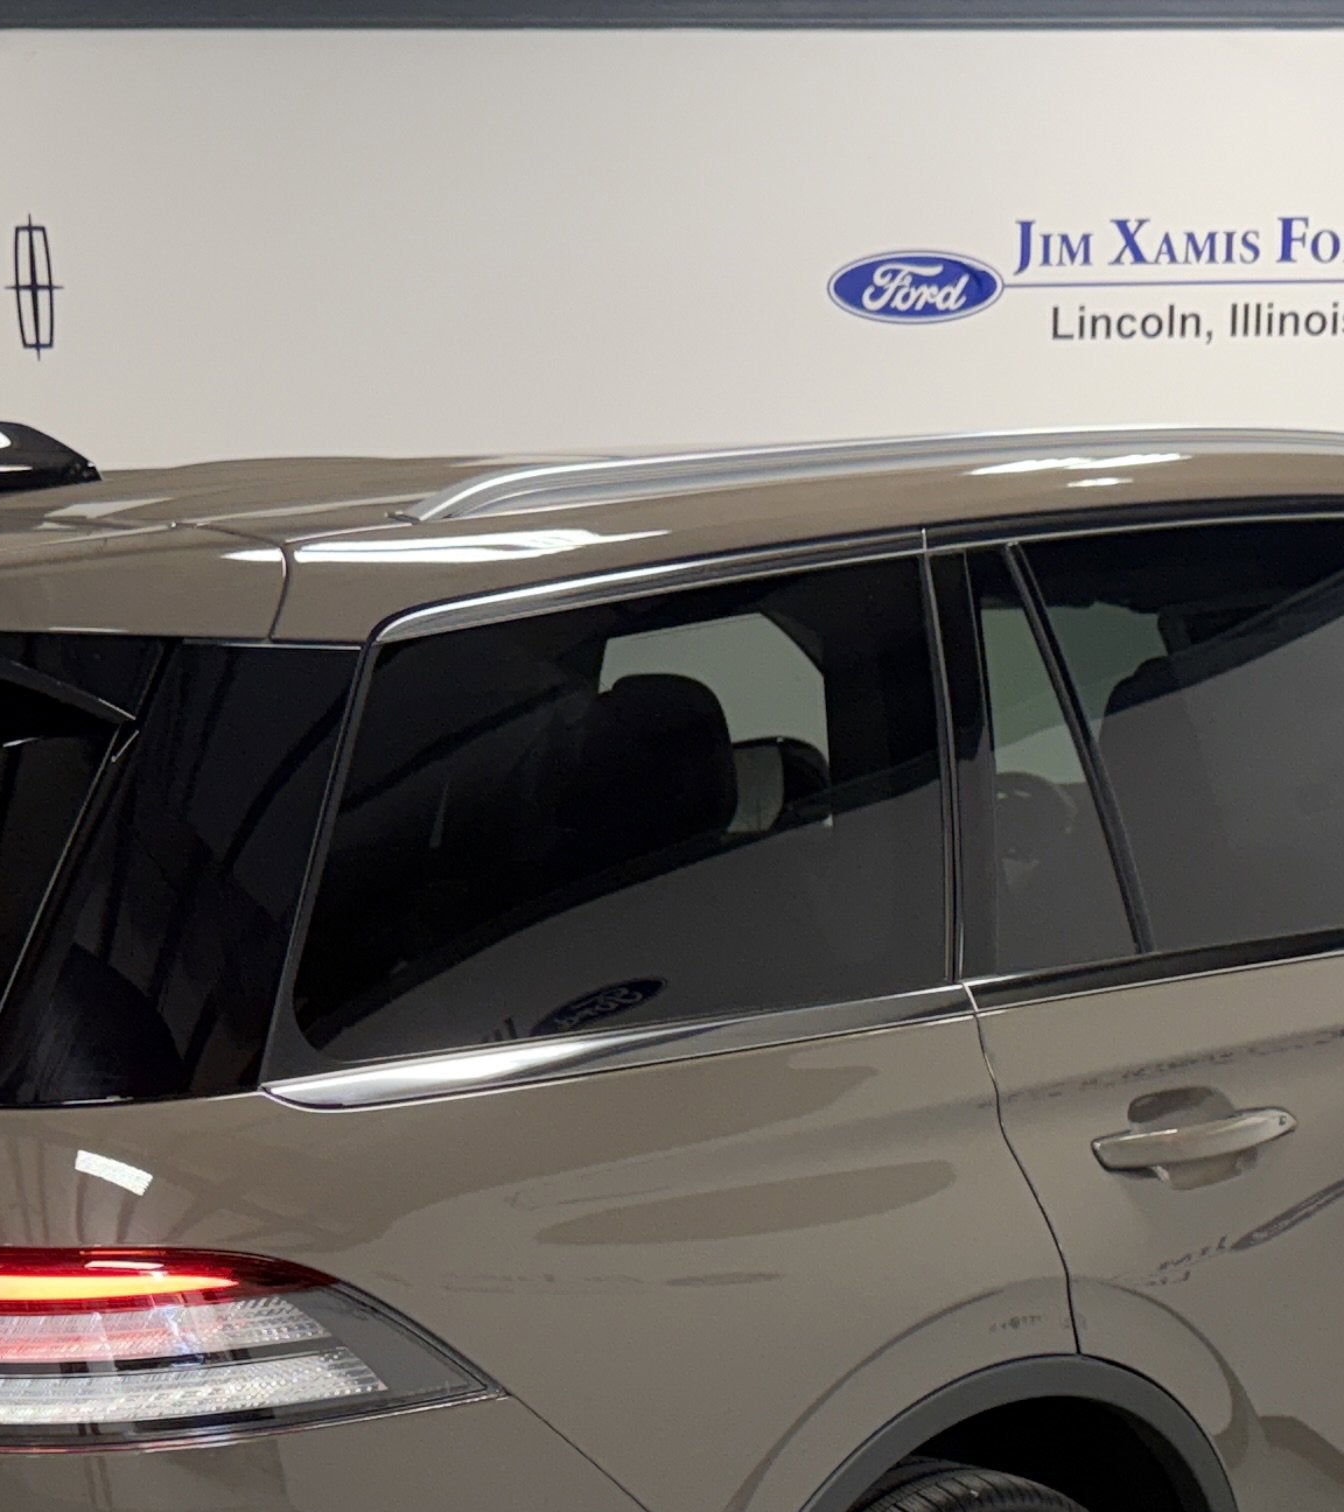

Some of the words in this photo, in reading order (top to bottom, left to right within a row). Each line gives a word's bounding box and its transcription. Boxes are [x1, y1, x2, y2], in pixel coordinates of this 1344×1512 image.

[1013, 219, 1092, 276] JIM
[1108, 217, 1261, 266] XAMIS
[1051, 303, 1213, 345] Lincoln,
